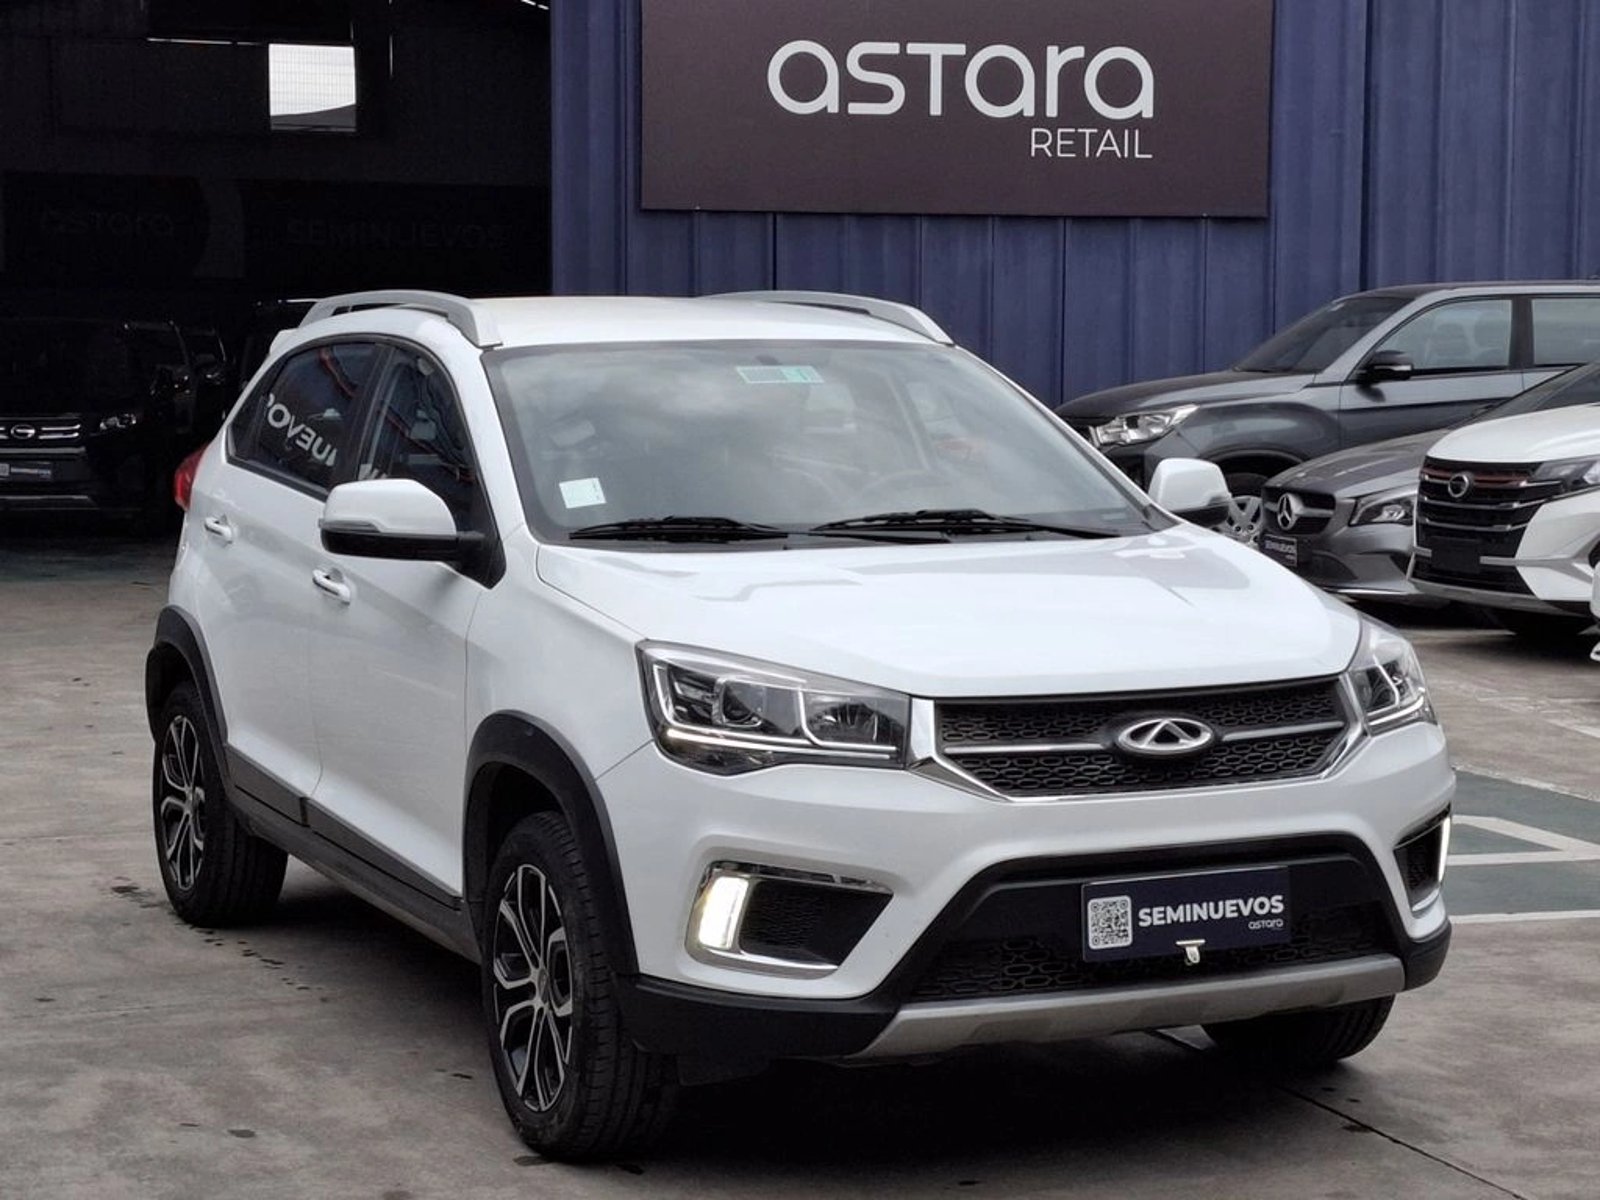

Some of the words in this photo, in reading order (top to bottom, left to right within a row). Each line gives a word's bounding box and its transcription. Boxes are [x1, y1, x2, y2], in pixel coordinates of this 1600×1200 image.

[767, 40, 1154, 120] astara
[1031, 127, 1153, 158] RETAIL
[1138, 895, 1285, 927] SEMINUEVOS
